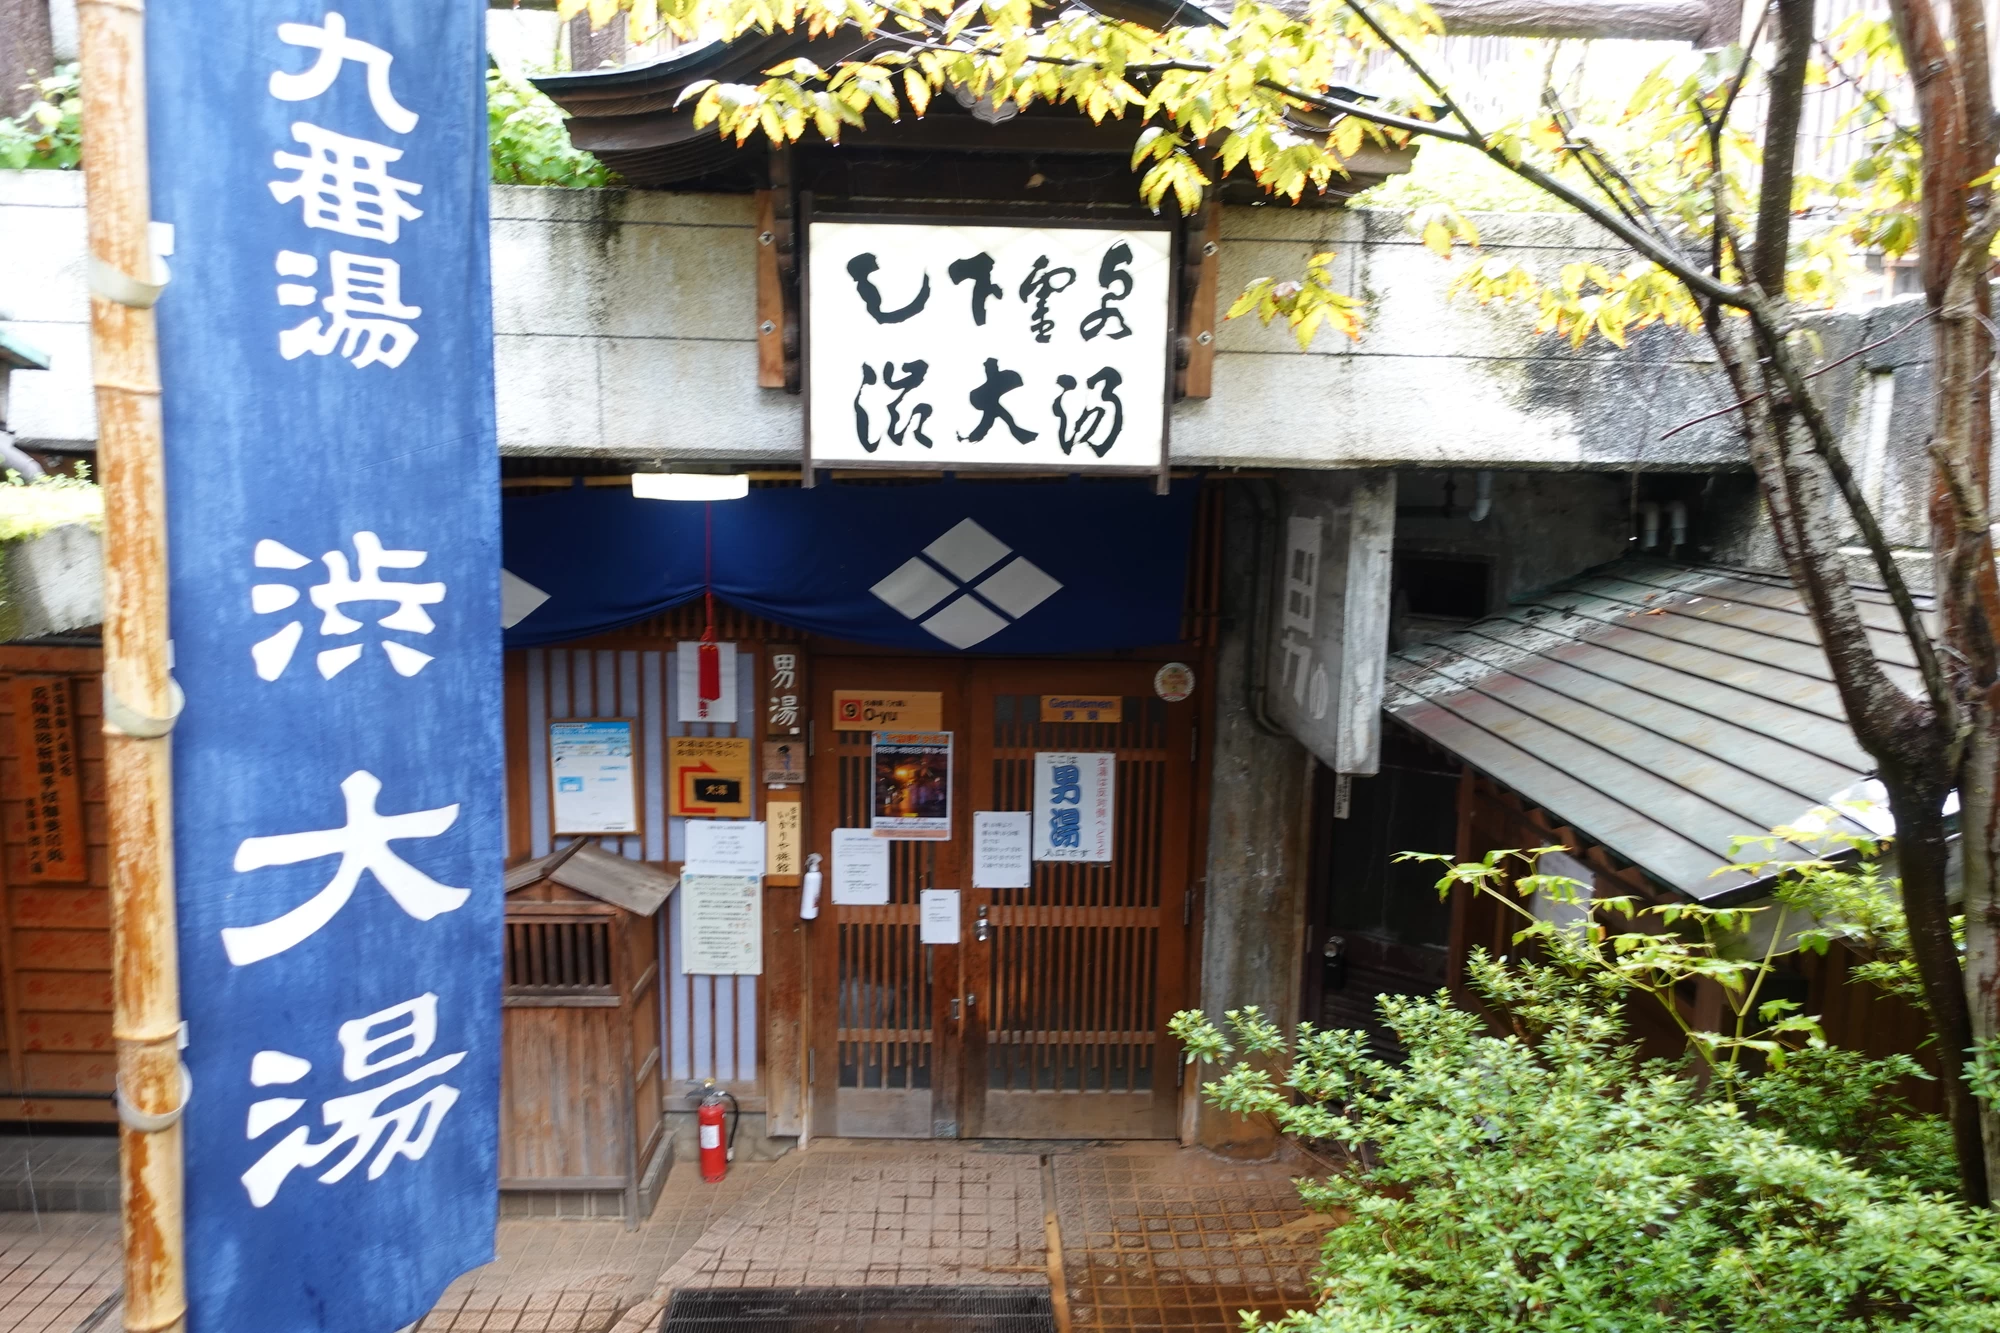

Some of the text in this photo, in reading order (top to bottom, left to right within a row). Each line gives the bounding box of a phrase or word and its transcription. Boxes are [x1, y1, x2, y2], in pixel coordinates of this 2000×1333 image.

[268, 12, 423, 369] 九番湯
[769, 654, 800, 726] 男湯
[844, 703, 857, 718] 9
[1048, 697, 1114, 709] Gentlemen
[863, 707, 898, 725] O-yu
[1047, 755, 1079, 765] ここは
[1049, 765, 1081, 848] 男湯
[1042, 849, 1092, 858] 入口です
[221, 531, 472, 1207] 渋大湯
